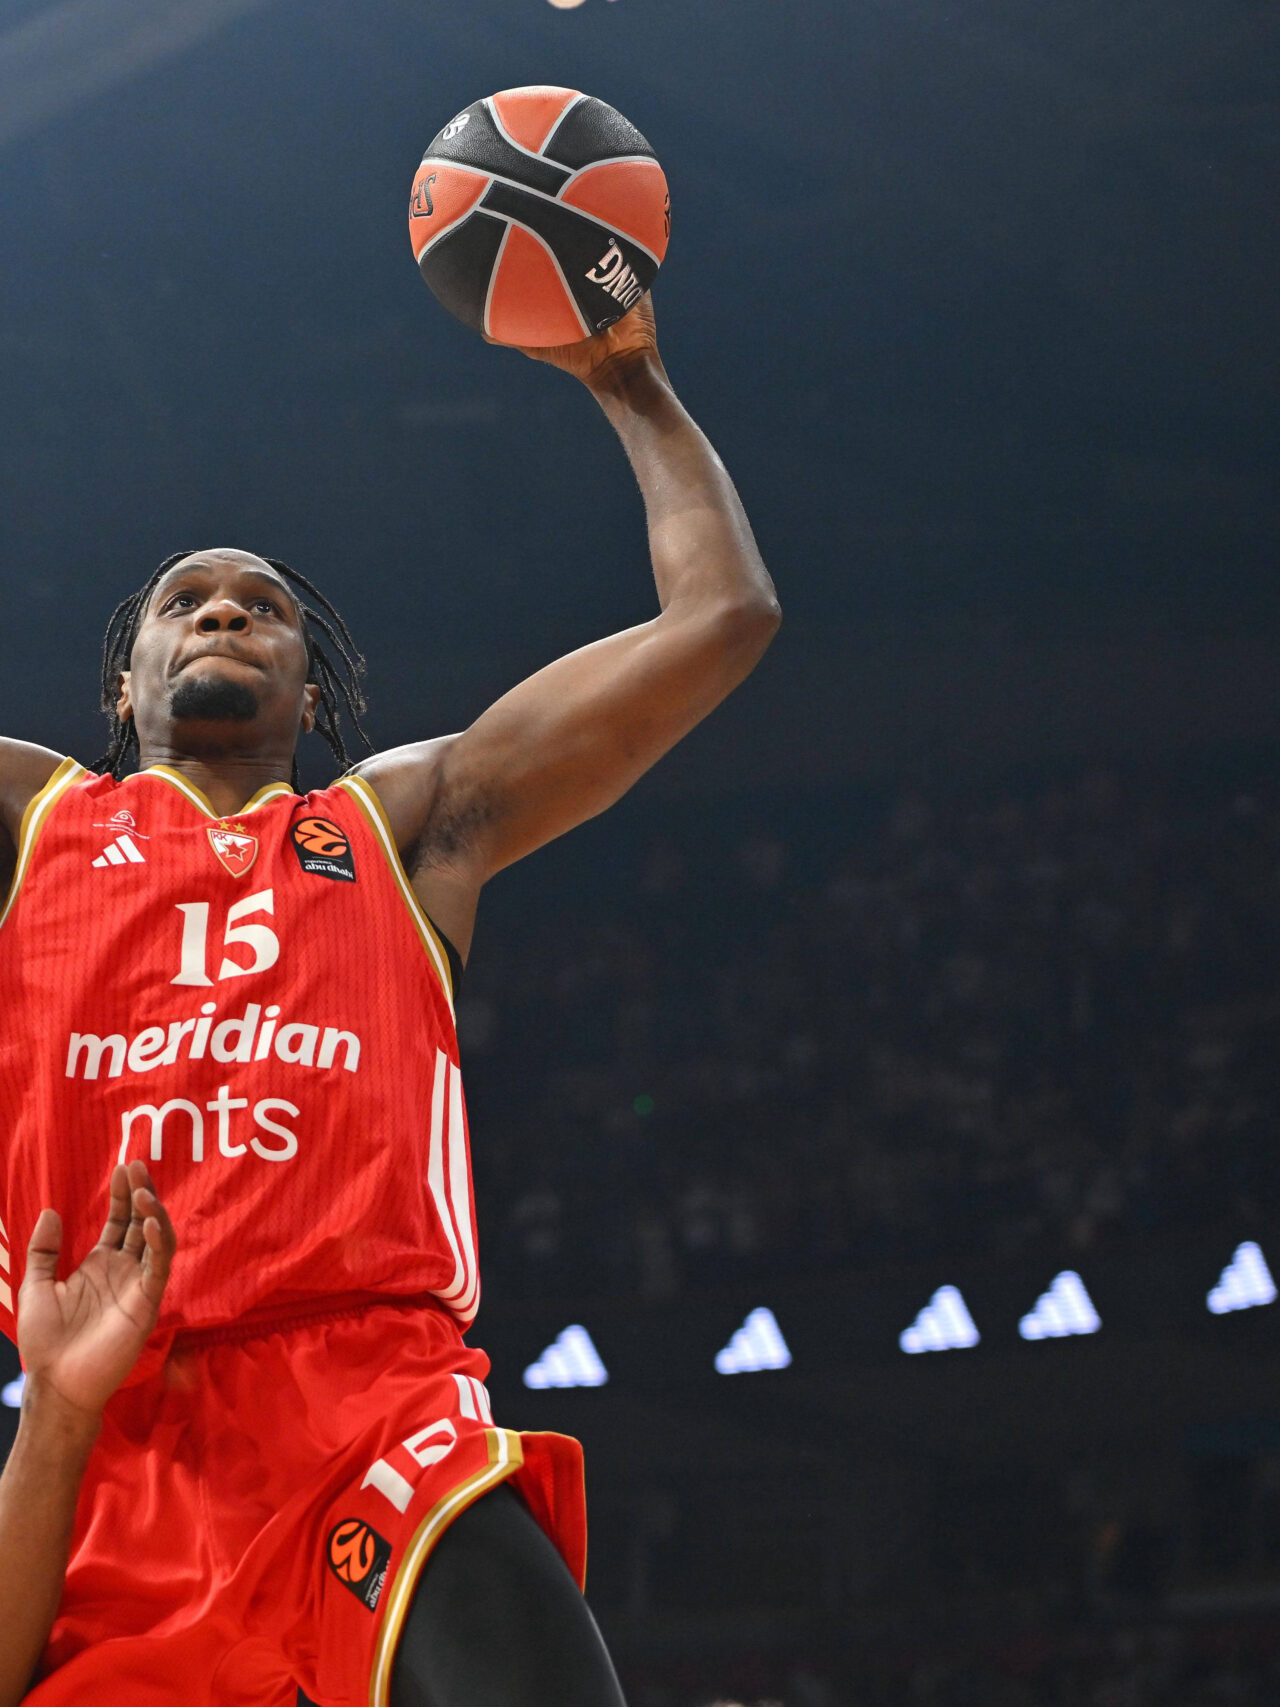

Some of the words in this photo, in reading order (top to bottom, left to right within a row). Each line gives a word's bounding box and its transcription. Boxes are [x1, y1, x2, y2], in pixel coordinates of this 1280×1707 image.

[305, 862, 326, 870] abu
[170, 888, 280, 987] 15
[65, 1002, 361, 1080] meridian
[117, 1085, 300, 1165] mts
